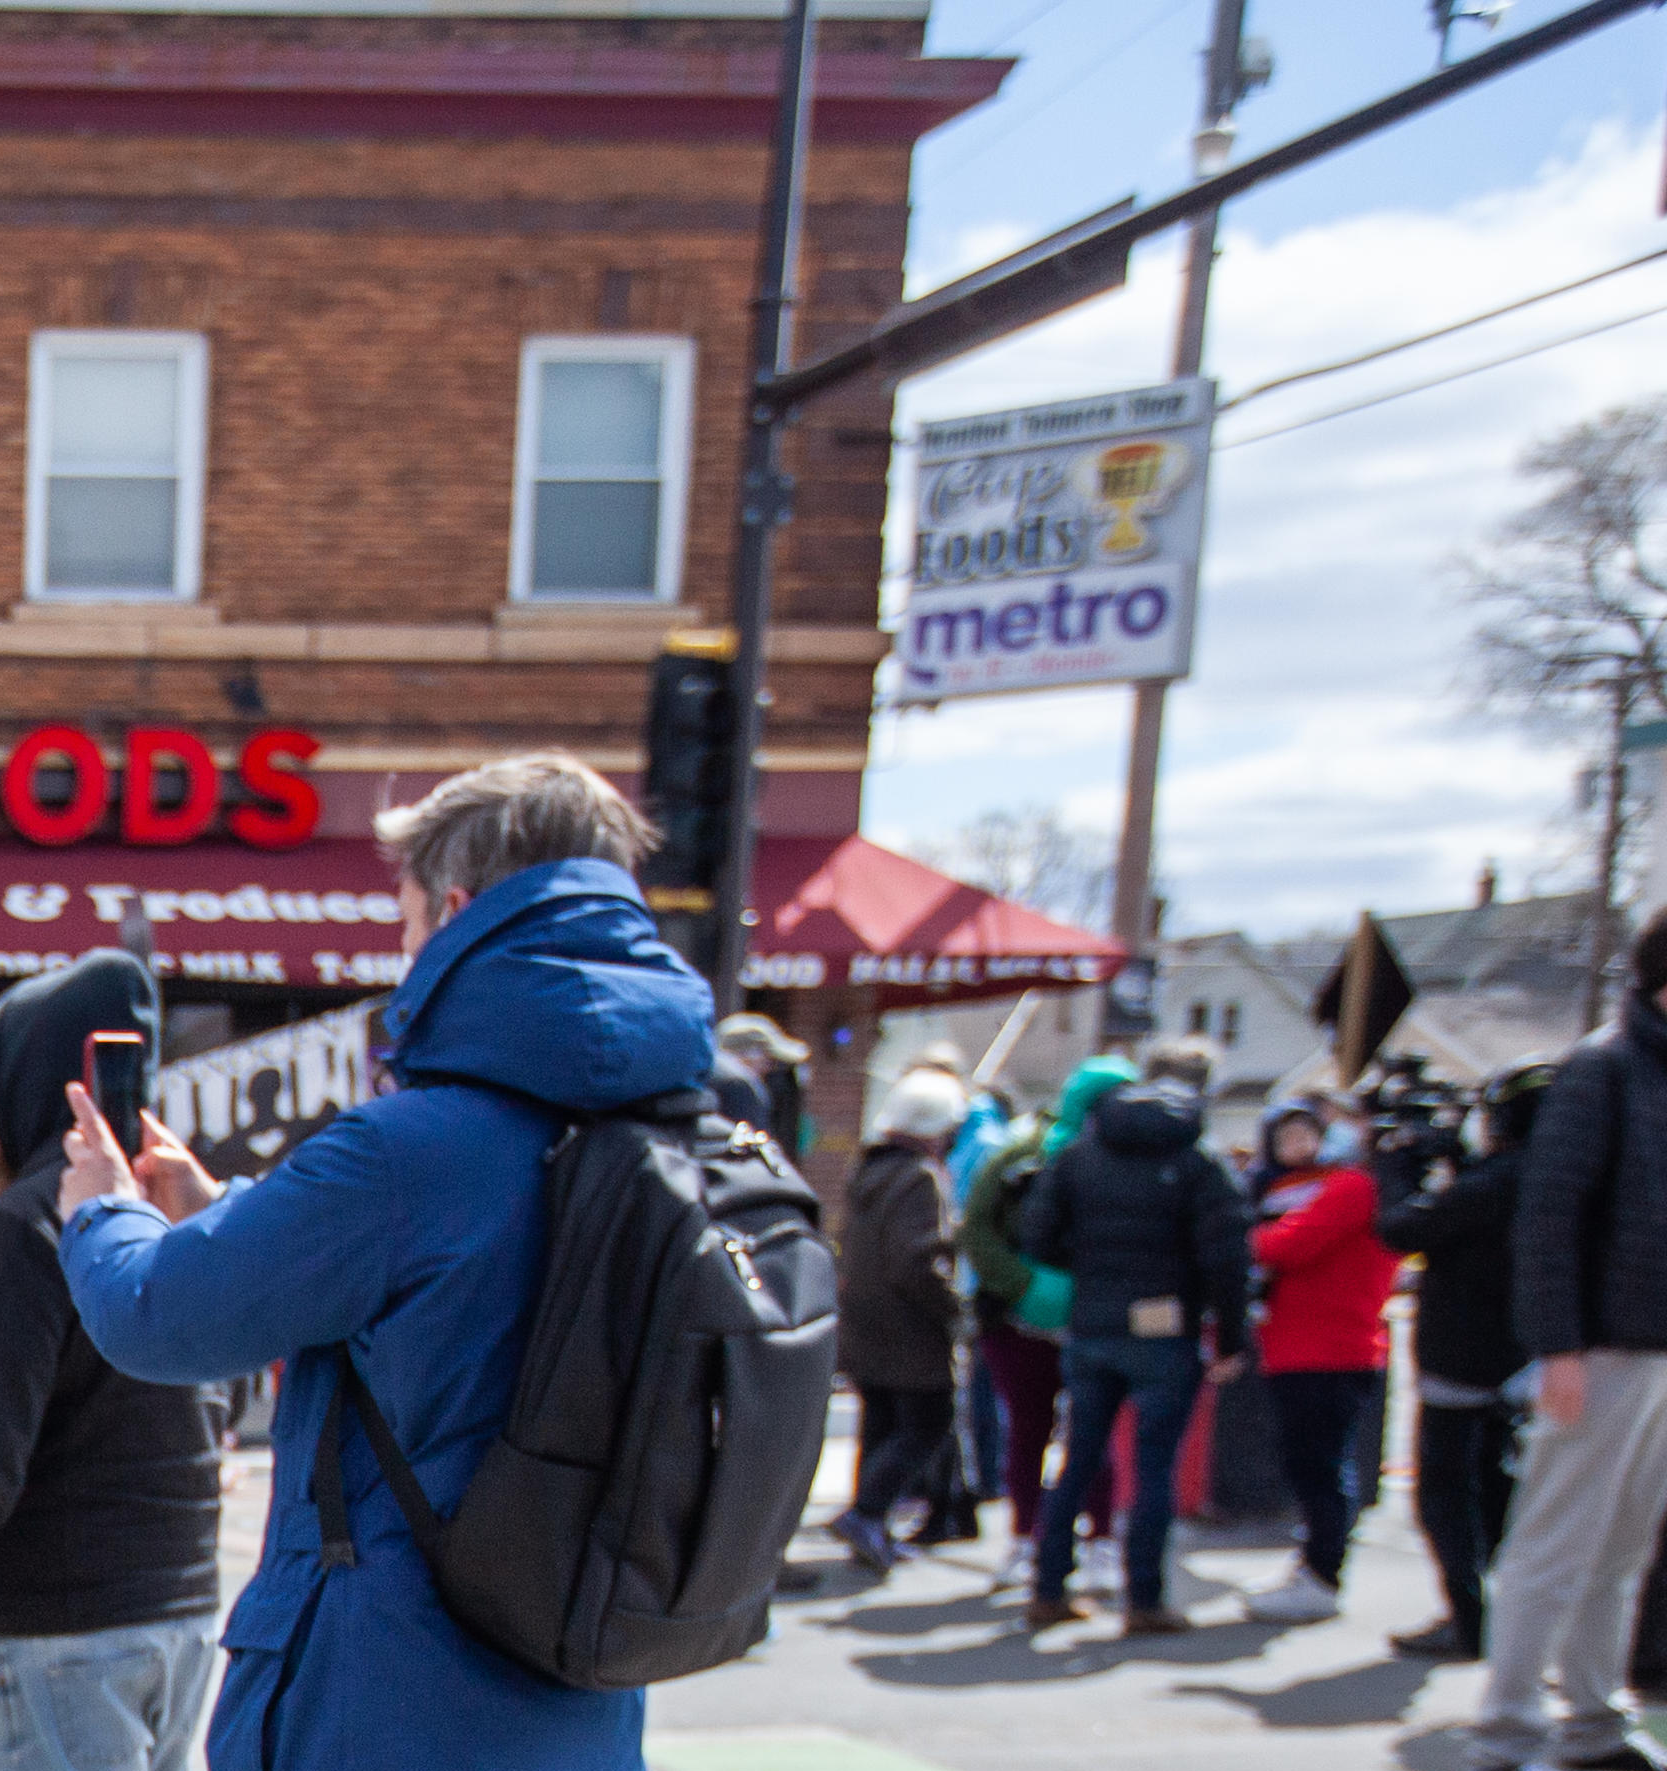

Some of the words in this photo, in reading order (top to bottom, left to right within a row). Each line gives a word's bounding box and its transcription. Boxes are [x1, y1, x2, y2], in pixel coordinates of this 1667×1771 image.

[914, 582, 1169, 656] metro
[2, 883, 70, 922] &
[180, 952, 288, 984] MILK
